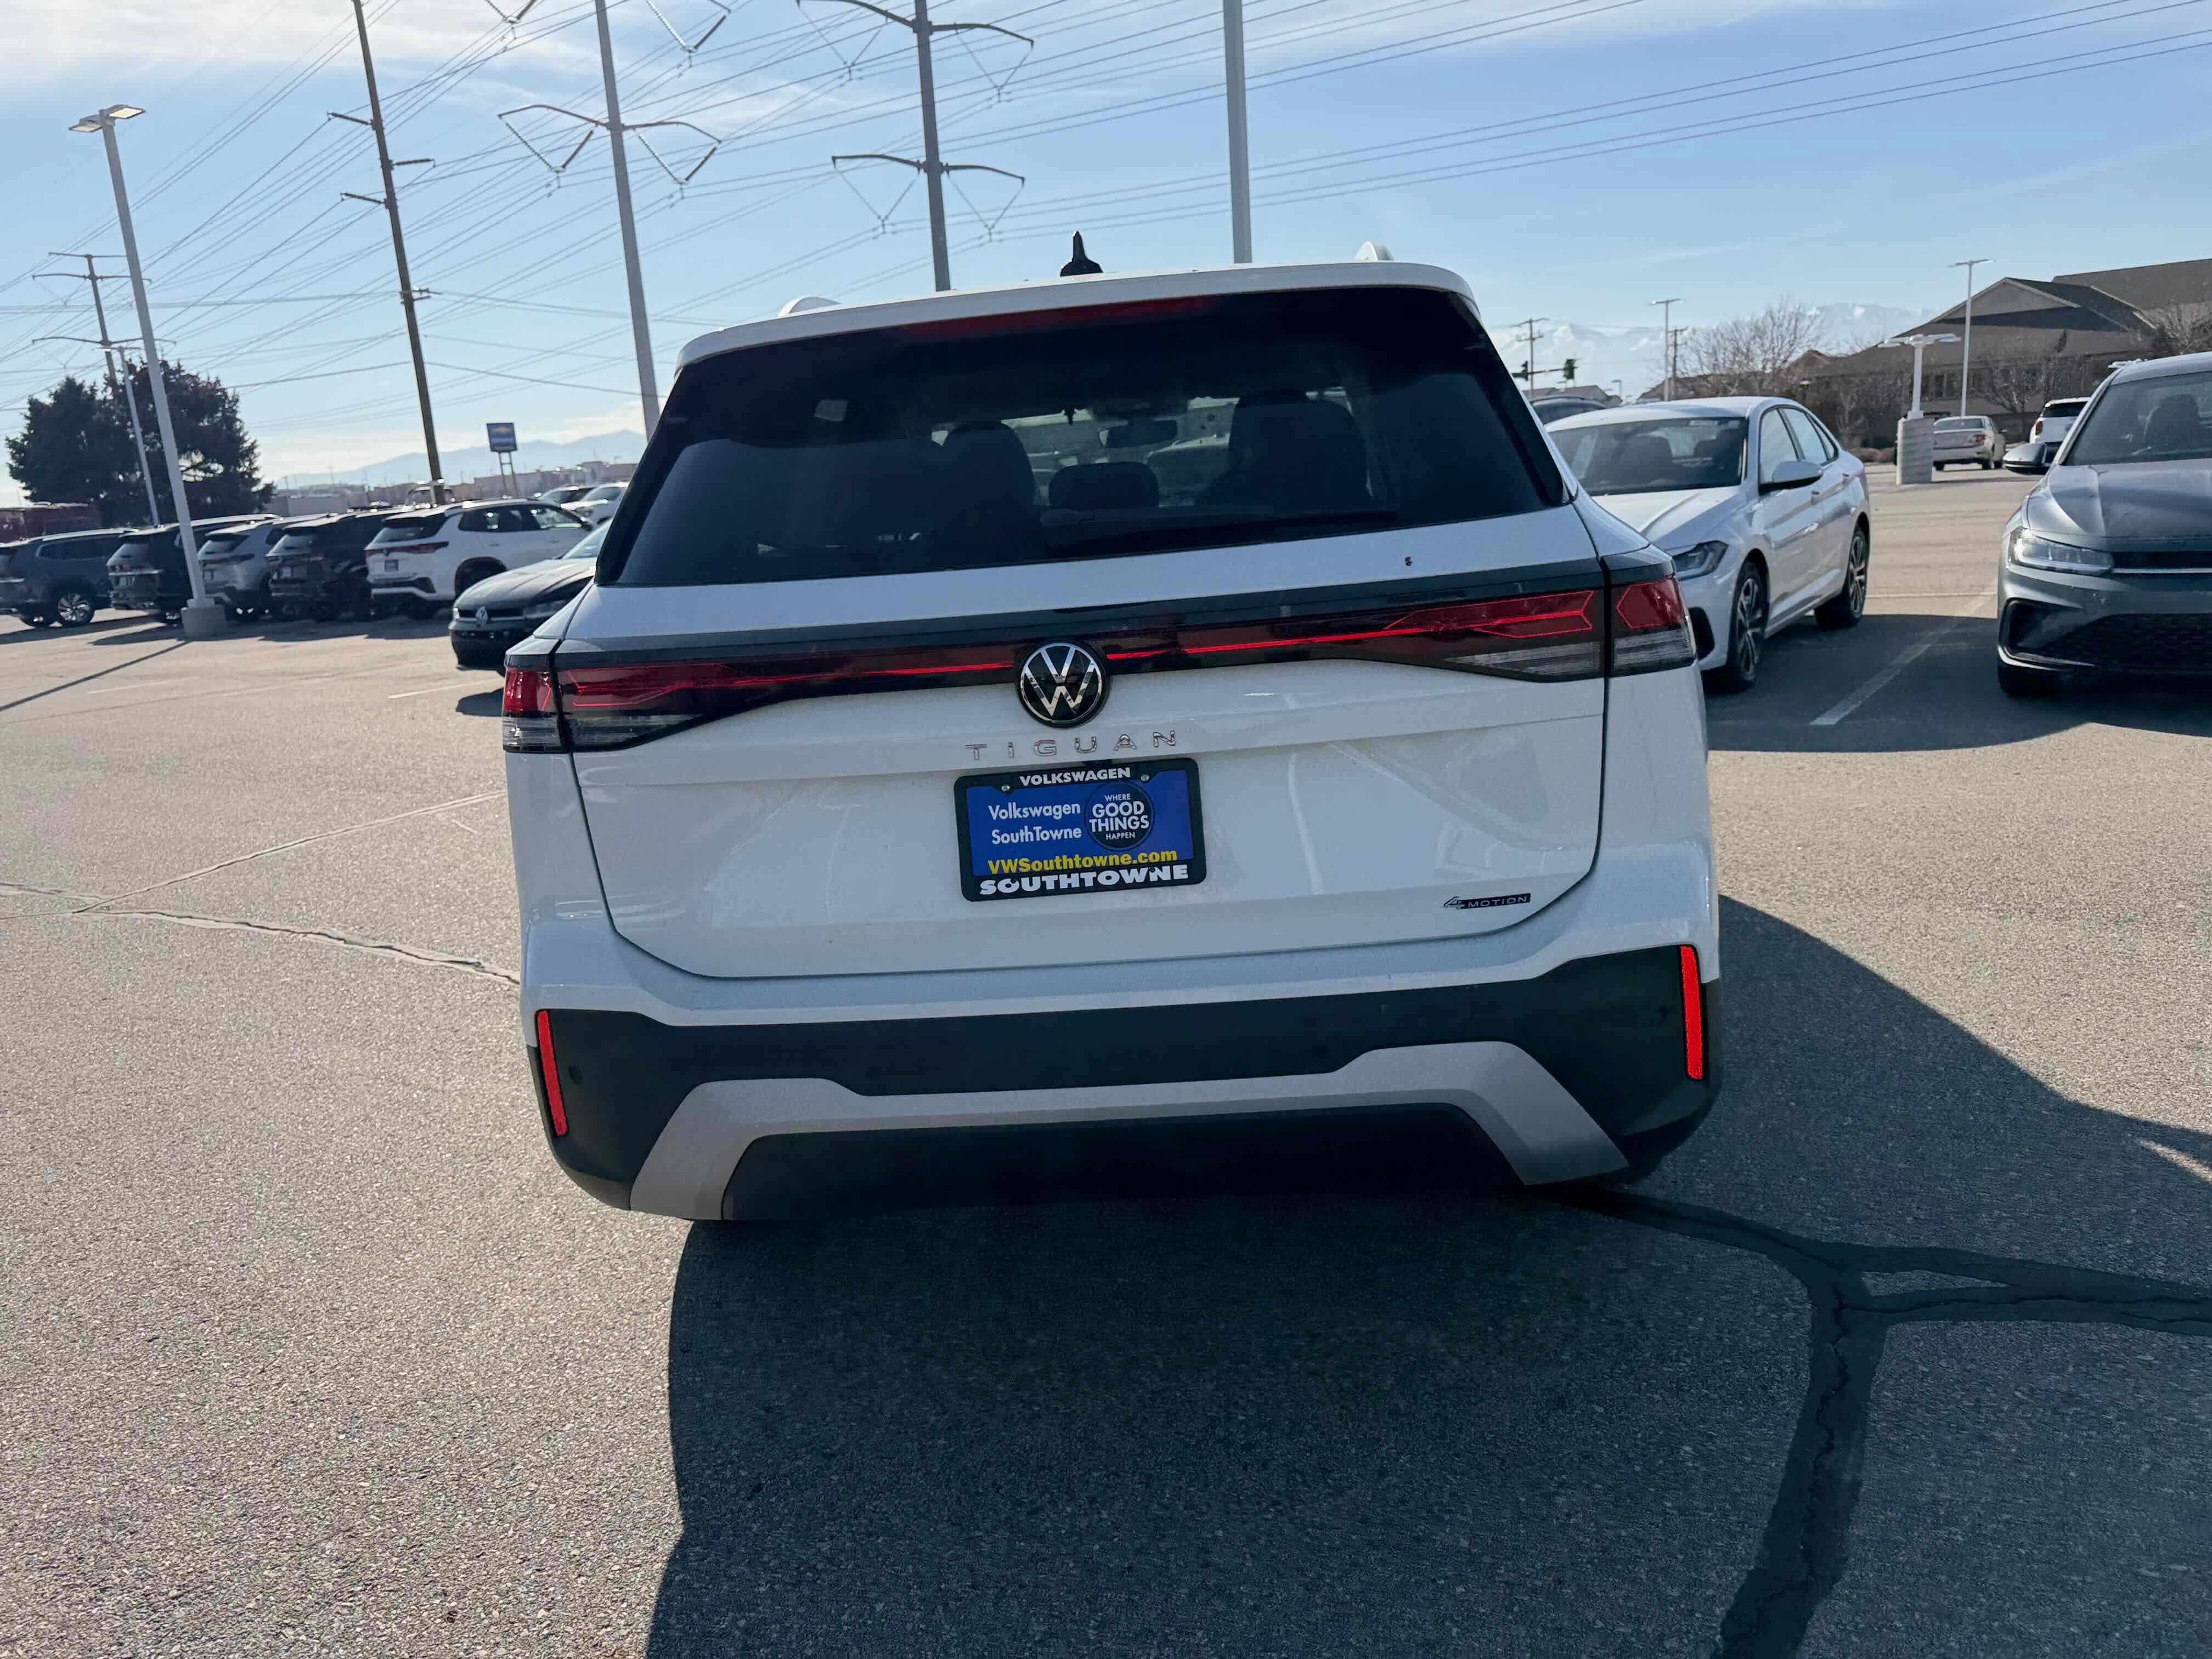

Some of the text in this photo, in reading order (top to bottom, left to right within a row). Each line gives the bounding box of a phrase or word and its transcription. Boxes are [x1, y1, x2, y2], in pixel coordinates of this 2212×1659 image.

[966, 730, 1177, 760] TIGUAN
[1019, 768, 1131, 786] VOLKSWAGEN
[988, 802, 1081, 822] Volkswagen
[1092, 801, 1144, 818] GOOD
[1089, 815, 1149, 832] THINGS
[991, 825, 1082, 845] SouthTowne
[988, 850, 1177, 875] VWSouthtowne.com
[980, 865, 1188, 895] SOUTHTOWNE
